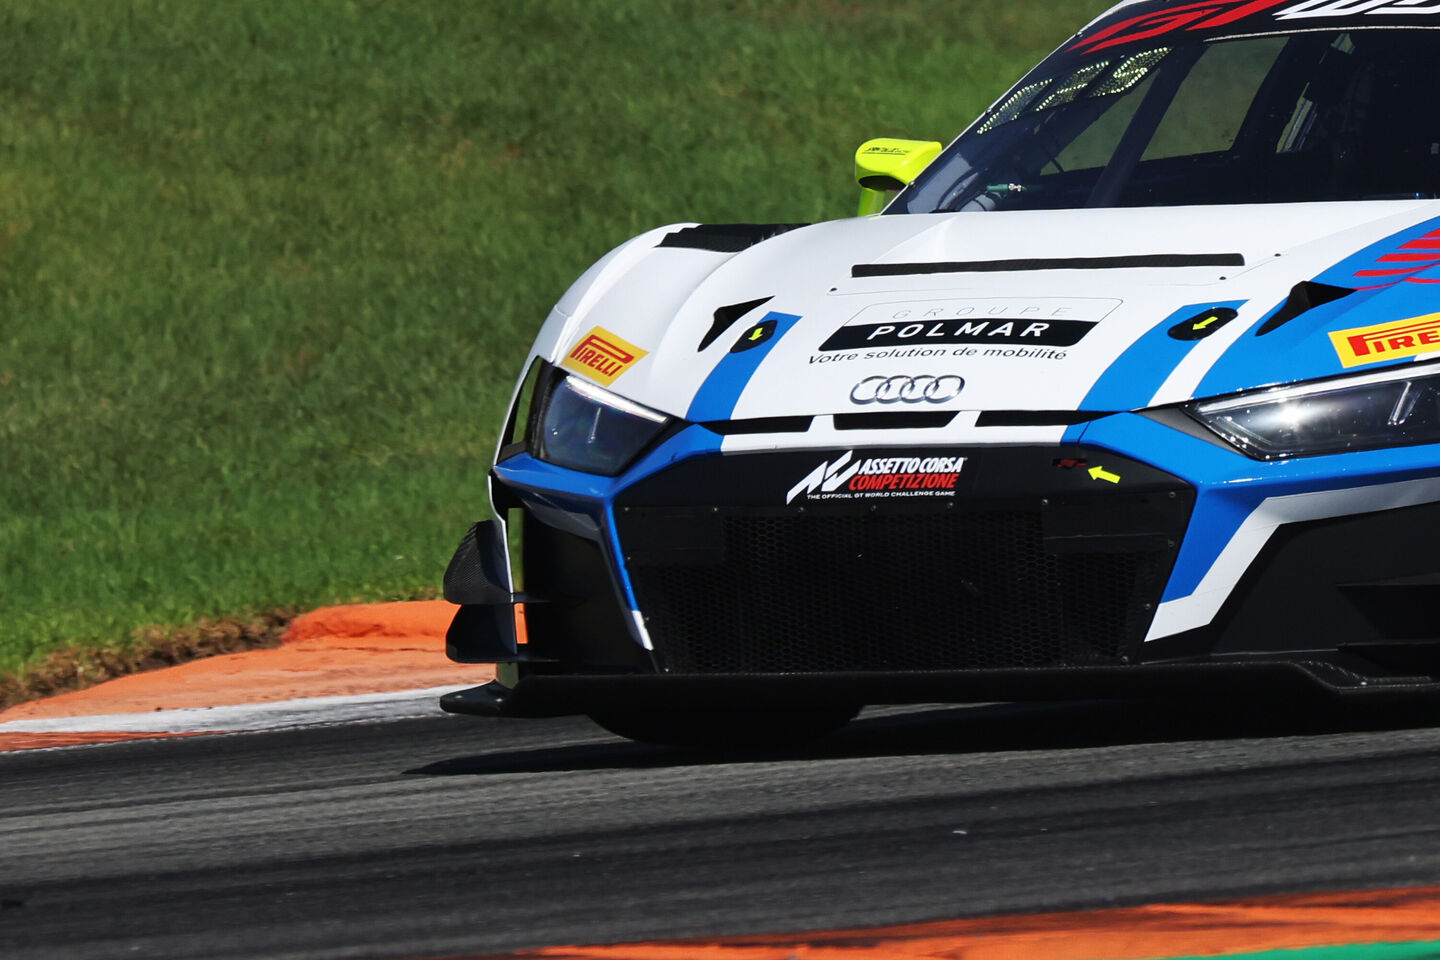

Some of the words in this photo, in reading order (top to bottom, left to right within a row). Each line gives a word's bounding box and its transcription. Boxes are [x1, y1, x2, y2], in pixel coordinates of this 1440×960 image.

[892, 306, 1073, 320] GROUPE
[866, 321, 1051, 341] POLMAR
[570, 333, 635, 377] PIRELLI
[808, 352, 858, 365] Votre
[863, 348, 947, 361] solution
[951, 346, 979, 358] de
[982, 348, 1067, 361] mobilité
[858, 458, 920, 475] ASSETTO
[918, 456, 966, 474] CORSA
[850, 473, 960, 491] COMPETIZIONE
